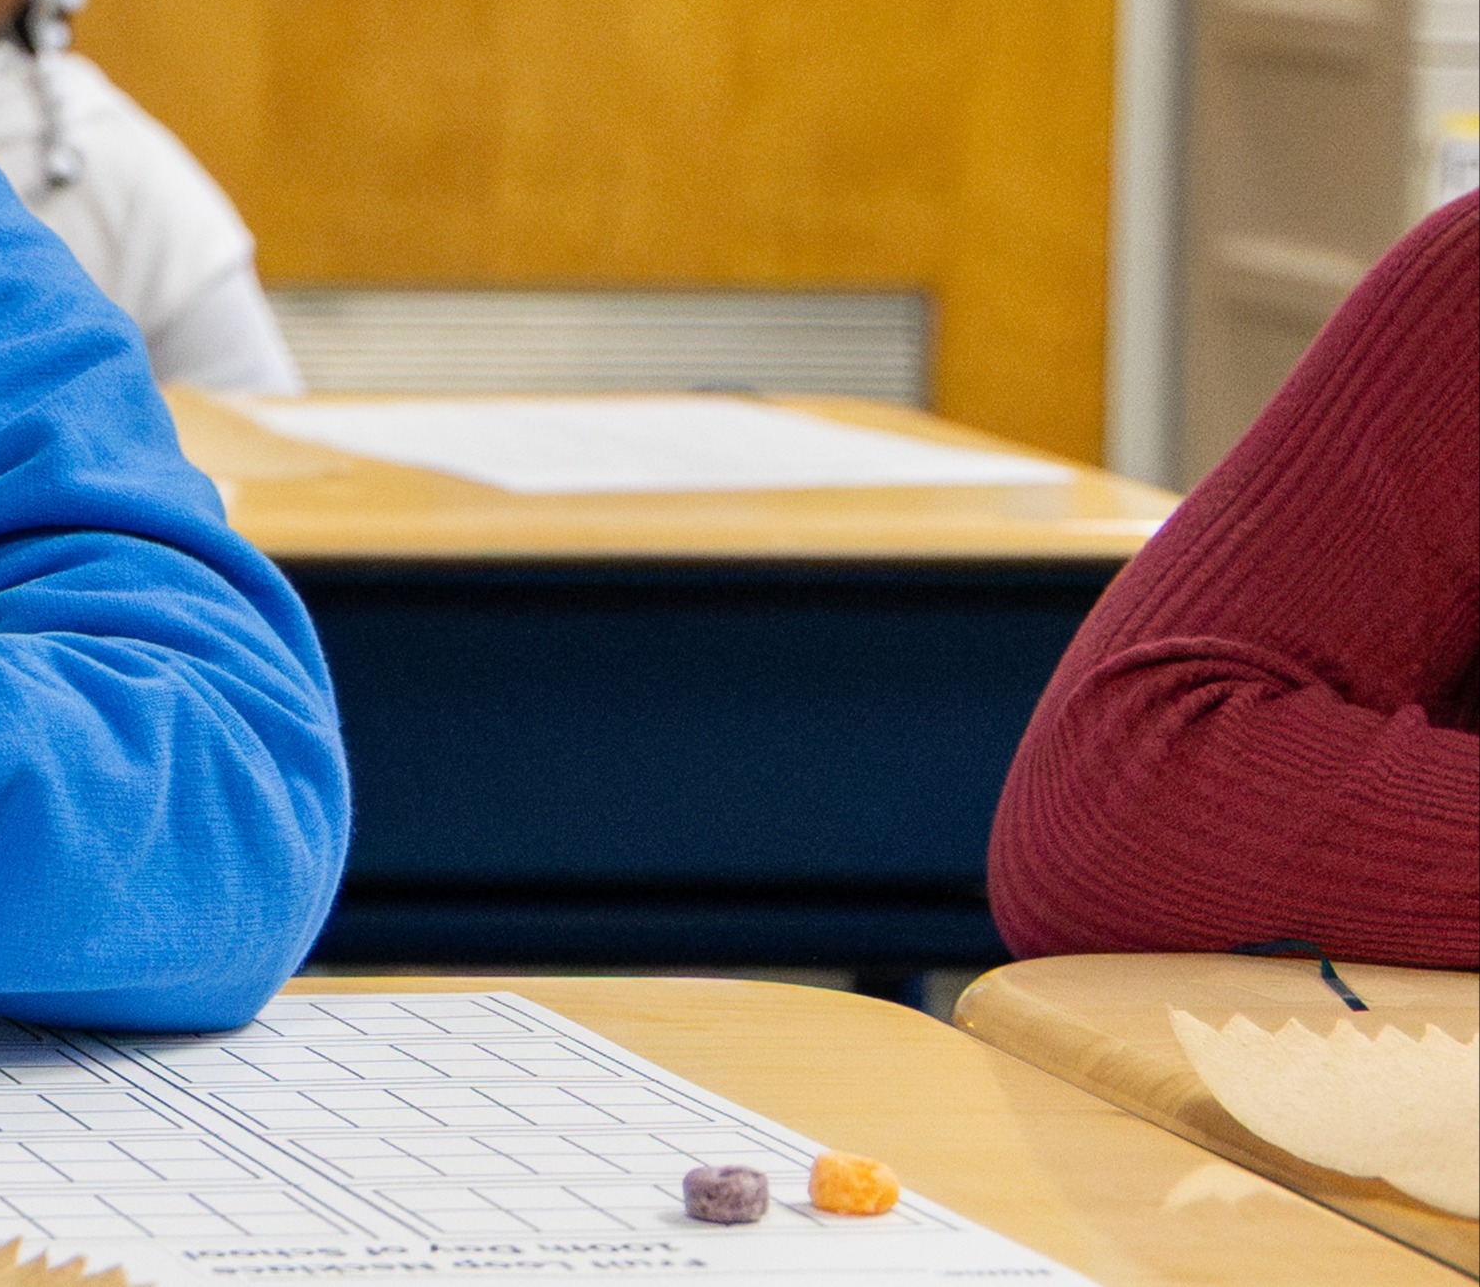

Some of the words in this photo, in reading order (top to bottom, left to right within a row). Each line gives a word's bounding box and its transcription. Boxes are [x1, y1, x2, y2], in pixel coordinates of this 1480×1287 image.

[180, 1246, 348, 1263] School
[365, 1244, 409, 1257] of
[428, 1241, 524, 1255] Day
[537, 1241, 681, 1255] 100th
[211, 1260, 438, 1275] Necklace
[451, 1258, 575, 1272] Loop
[590, 1257, 709, 1271] Fruit
